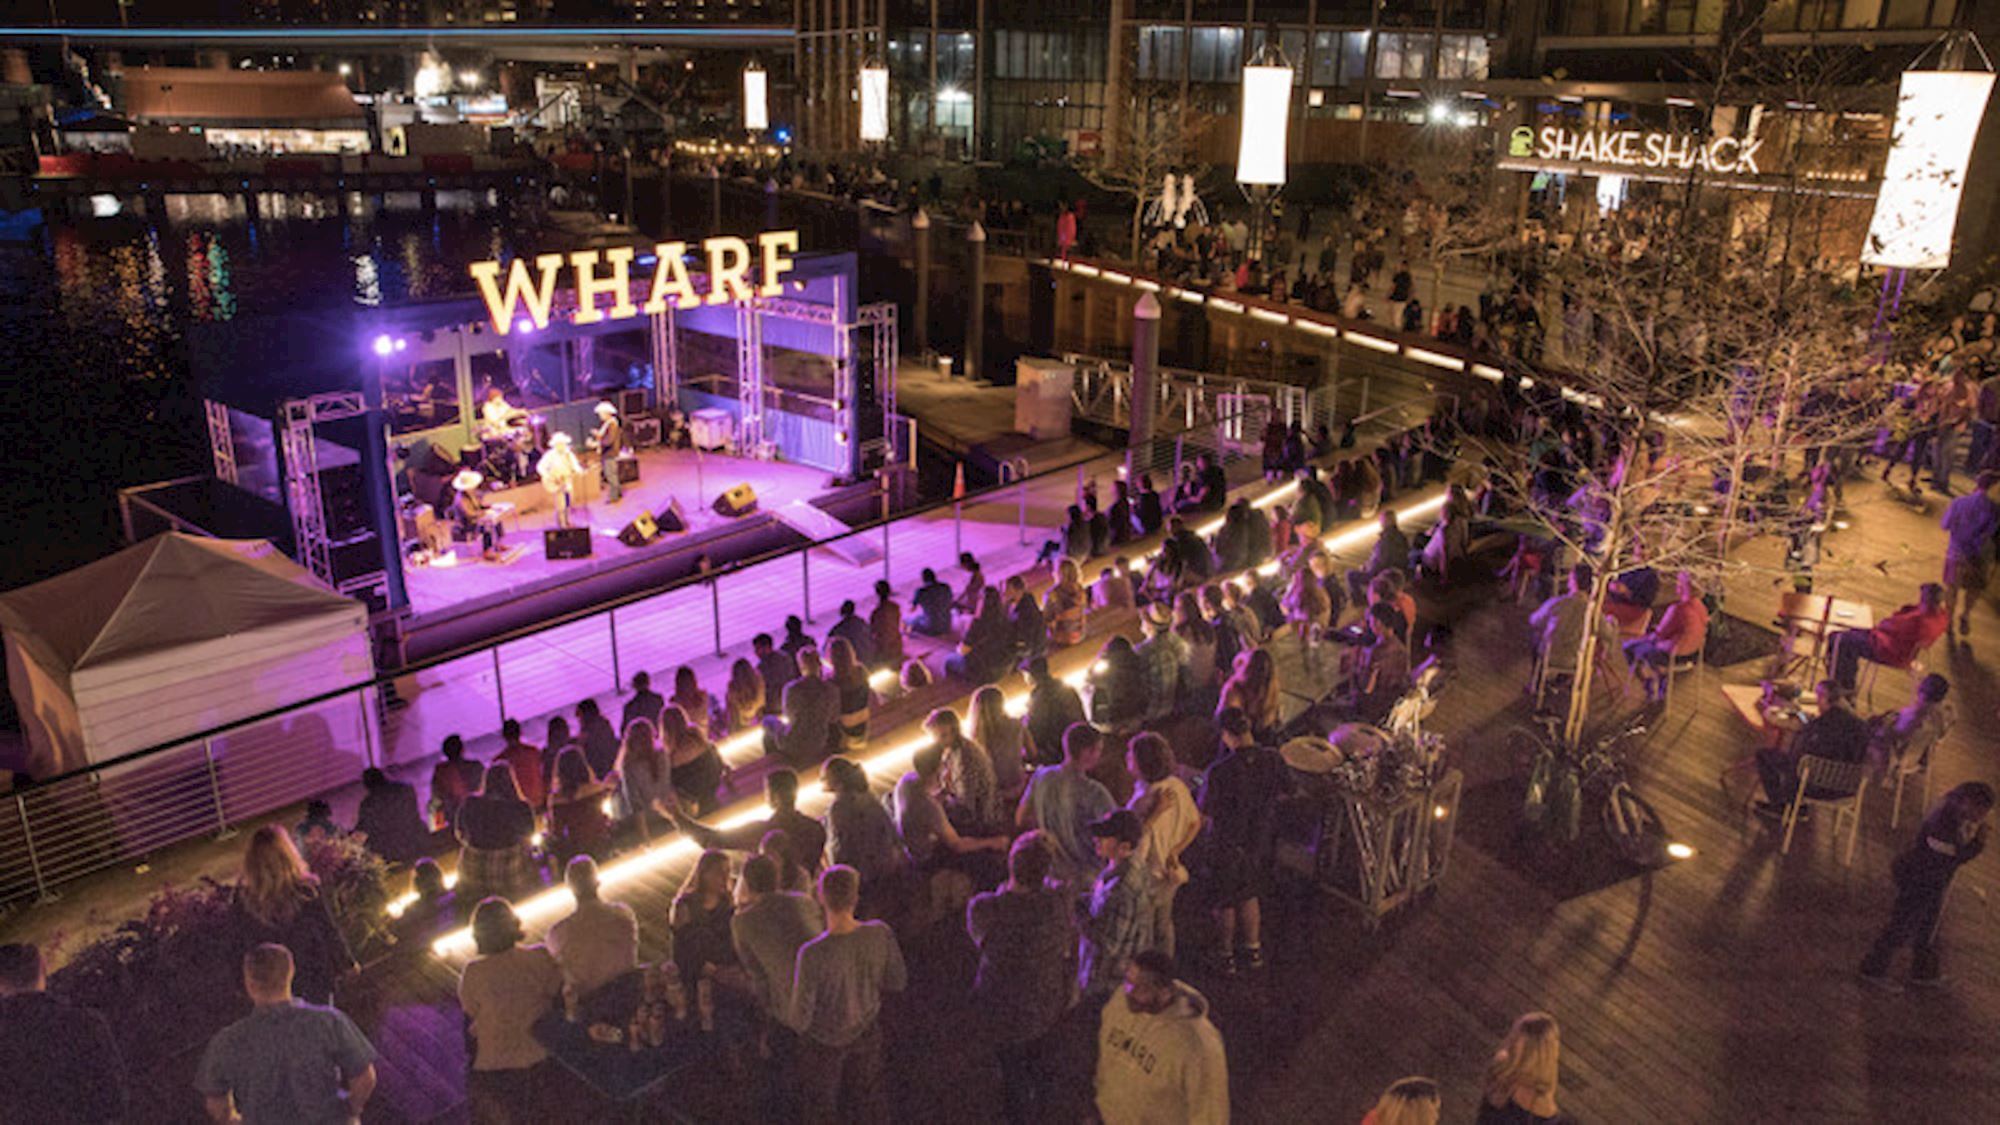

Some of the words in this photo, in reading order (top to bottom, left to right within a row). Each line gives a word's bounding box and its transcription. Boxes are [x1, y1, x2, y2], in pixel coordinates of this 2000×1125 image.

[1538, 126, 1640, 166] SHAKE
[1645, 133, 1765, 174] SHACK
[469, 230, 800, 336] WHARF
